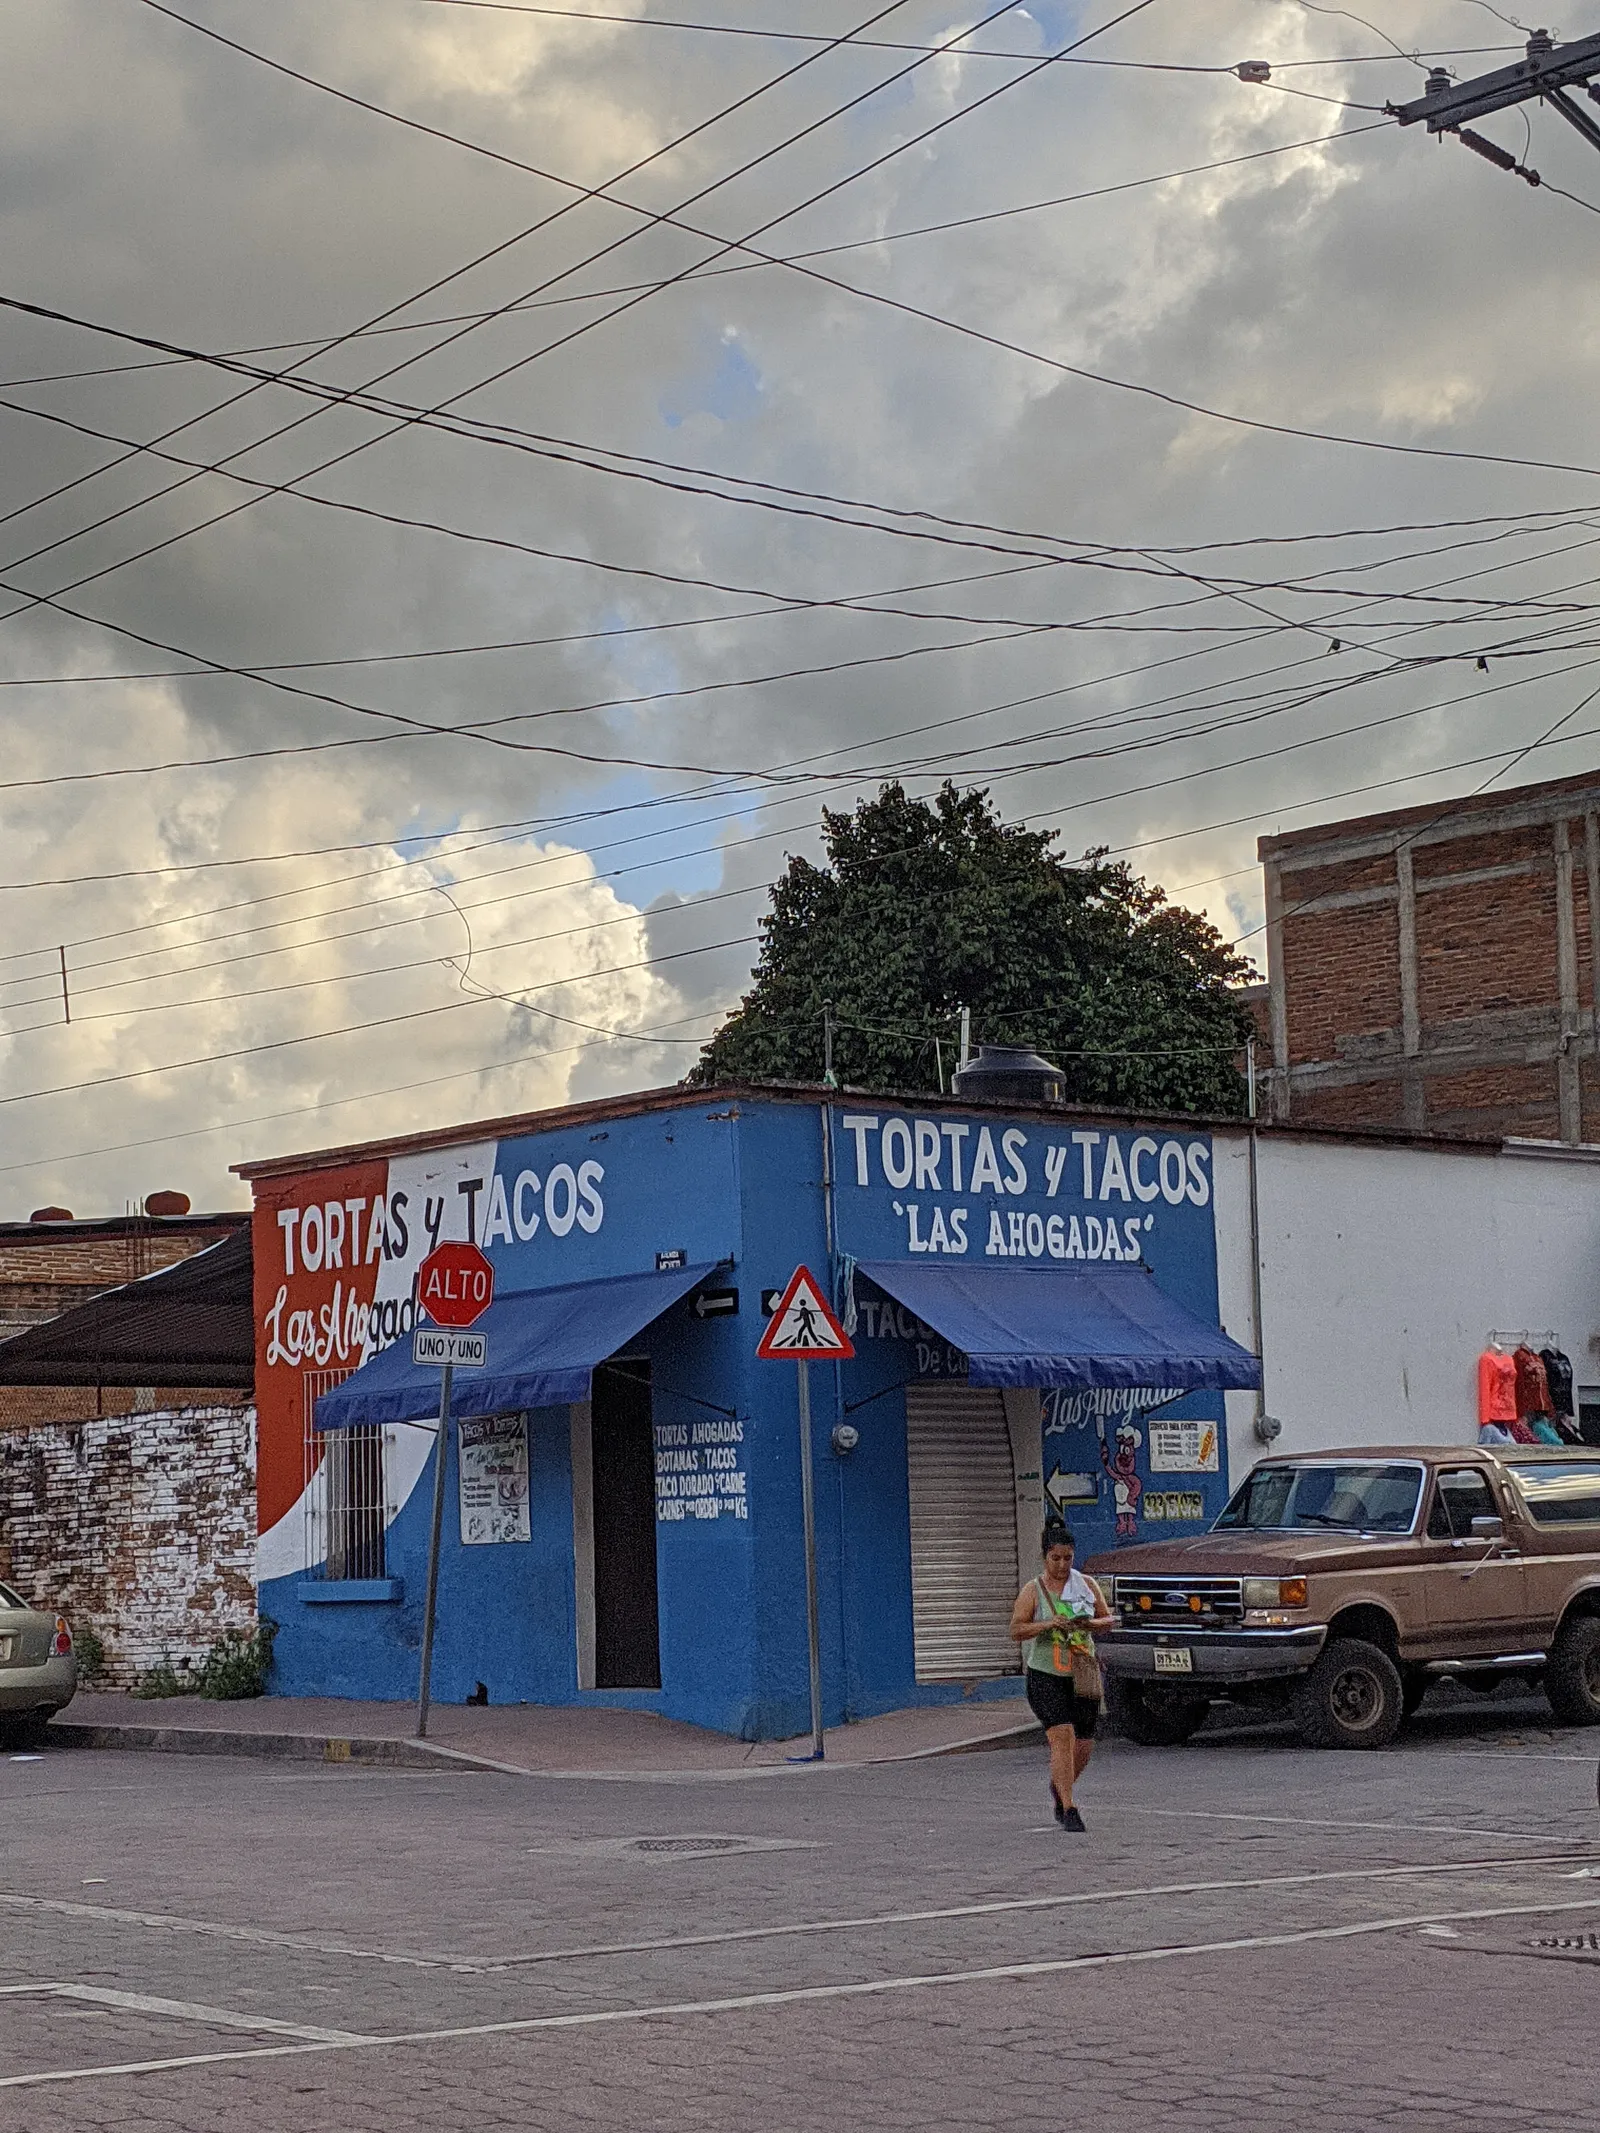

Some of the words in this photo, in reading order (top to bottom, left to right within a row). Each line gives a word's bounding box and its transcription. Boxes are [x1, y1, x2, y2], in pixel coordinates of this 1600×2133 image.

[843, 1115, 1028, 1195] TORTAS
[1072, 1132, 1210, 1206] TACOS
[277, 1191, 409, 1276] TORTAS
[458, 1160, 605, 1250] TACOS
[425, 1268, 487, 1302] ALTO
[264, 1285, 316, 1366] Las
[419, 1337, 445, 1356] UNO
[448, 1340, 456, 1357] Y
[458, 1340, 483, 1359] UNO
[656, 1425, 688, 1446] TORTAS
[692, 1421, 744, 1444] AHOGADAS
[657, 1450, 699, 1472] BOTANAS
[704, 1447, 737, 1469] TACOS
[656, 1475, 678, 1497] TACO
[680, 1473, 714, 1496] DORADO
[735, 1496, 748, 1519] KG
